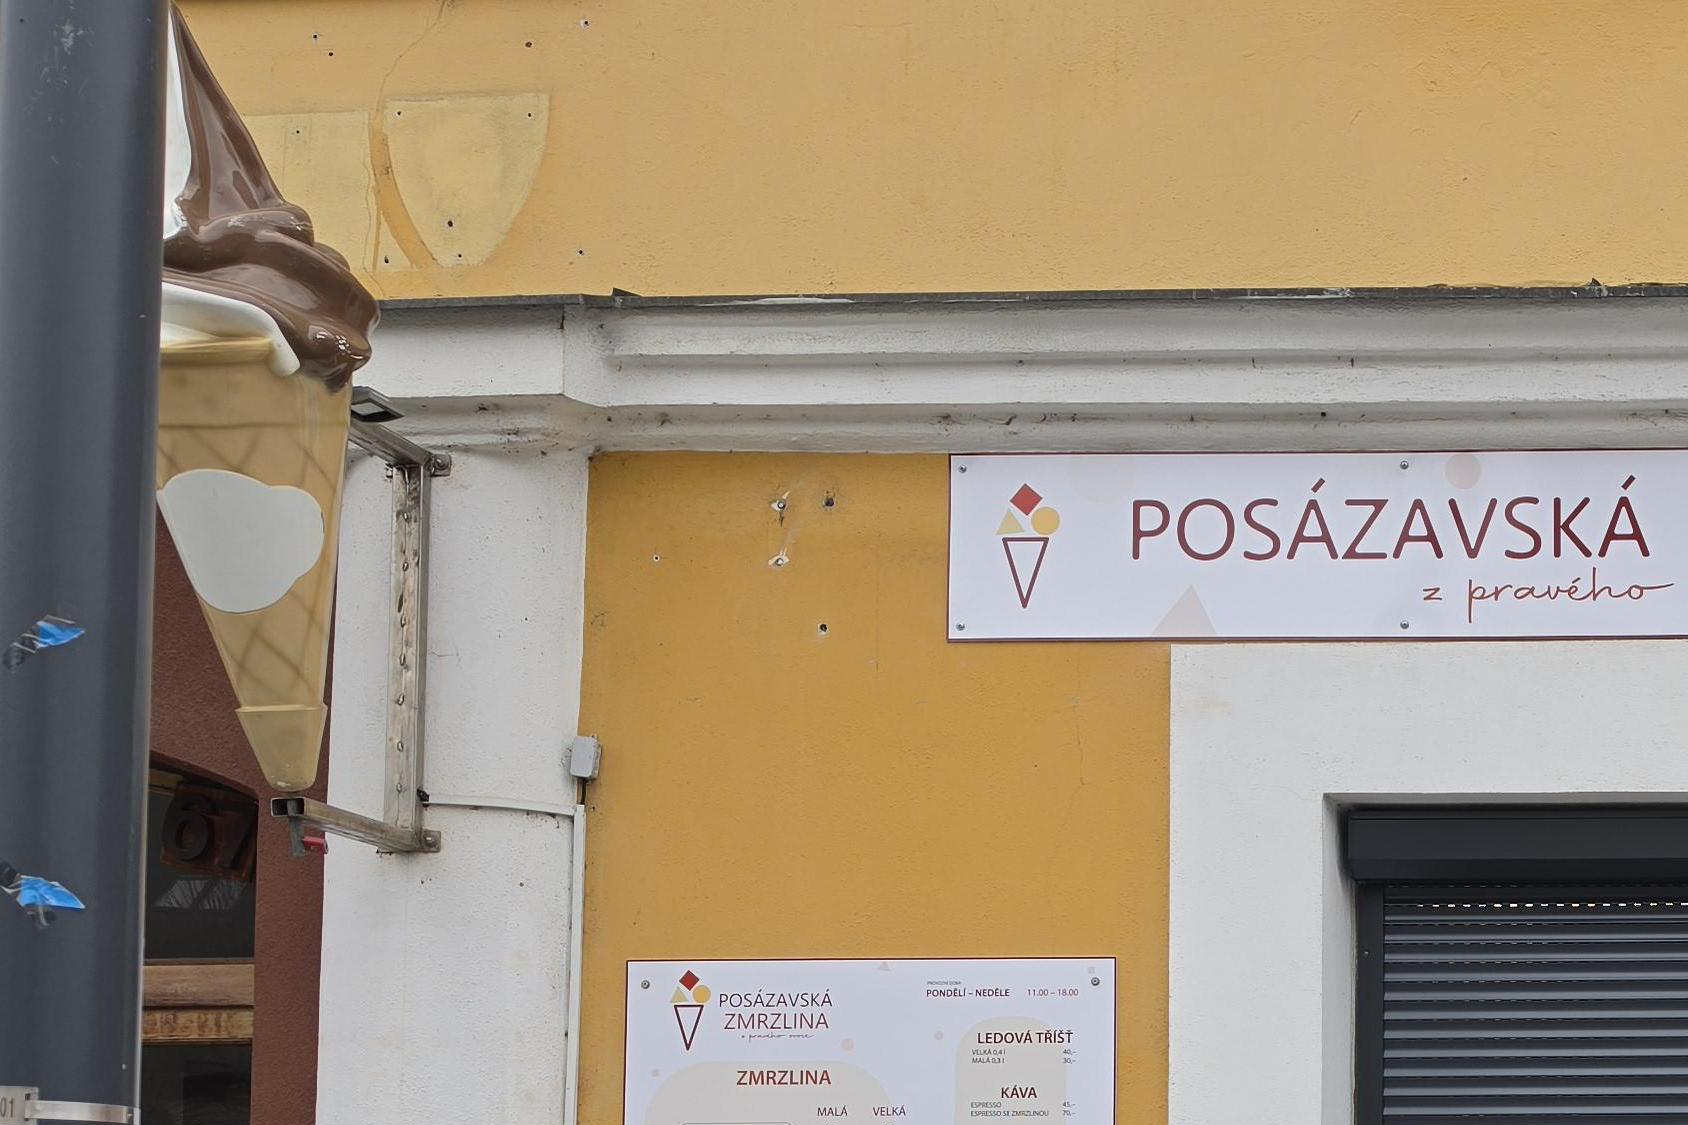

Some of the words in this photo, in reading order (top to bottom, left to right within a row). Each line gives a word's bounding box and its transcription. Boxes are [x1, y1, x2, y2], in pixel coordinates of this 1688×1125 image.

[1131, 475, 1650, 562] POSÁZAVSKÁ
[1422, 585, 1443, 601] z
[1468, 566, 1676, 624] pravého
[719, 988, 833, 1008] POSÁZAVSKÁ
[926, 987, 966, 998] PONDĚLÍ
[975, 987, 1011, 998] NEDĚLE
[1027, 988, 1049, 997] 11.00
[1057, 988, 1079, 997] 18.00
[724, 1012, 829, 1030] ZMRZLINA
[977, 1029, 1033, 1044] LEDOVÁ
[1036, 1029, 1074, 1044] TŘÍŠŤ
[736, 1069, 832, 1086] ZMRZLINA
[1001, 1084, 1038, 1099] KÁVA
[817, 1105, 848, 1117] MALÁ
[873, 1105, 906, 1117] VELKÁ
